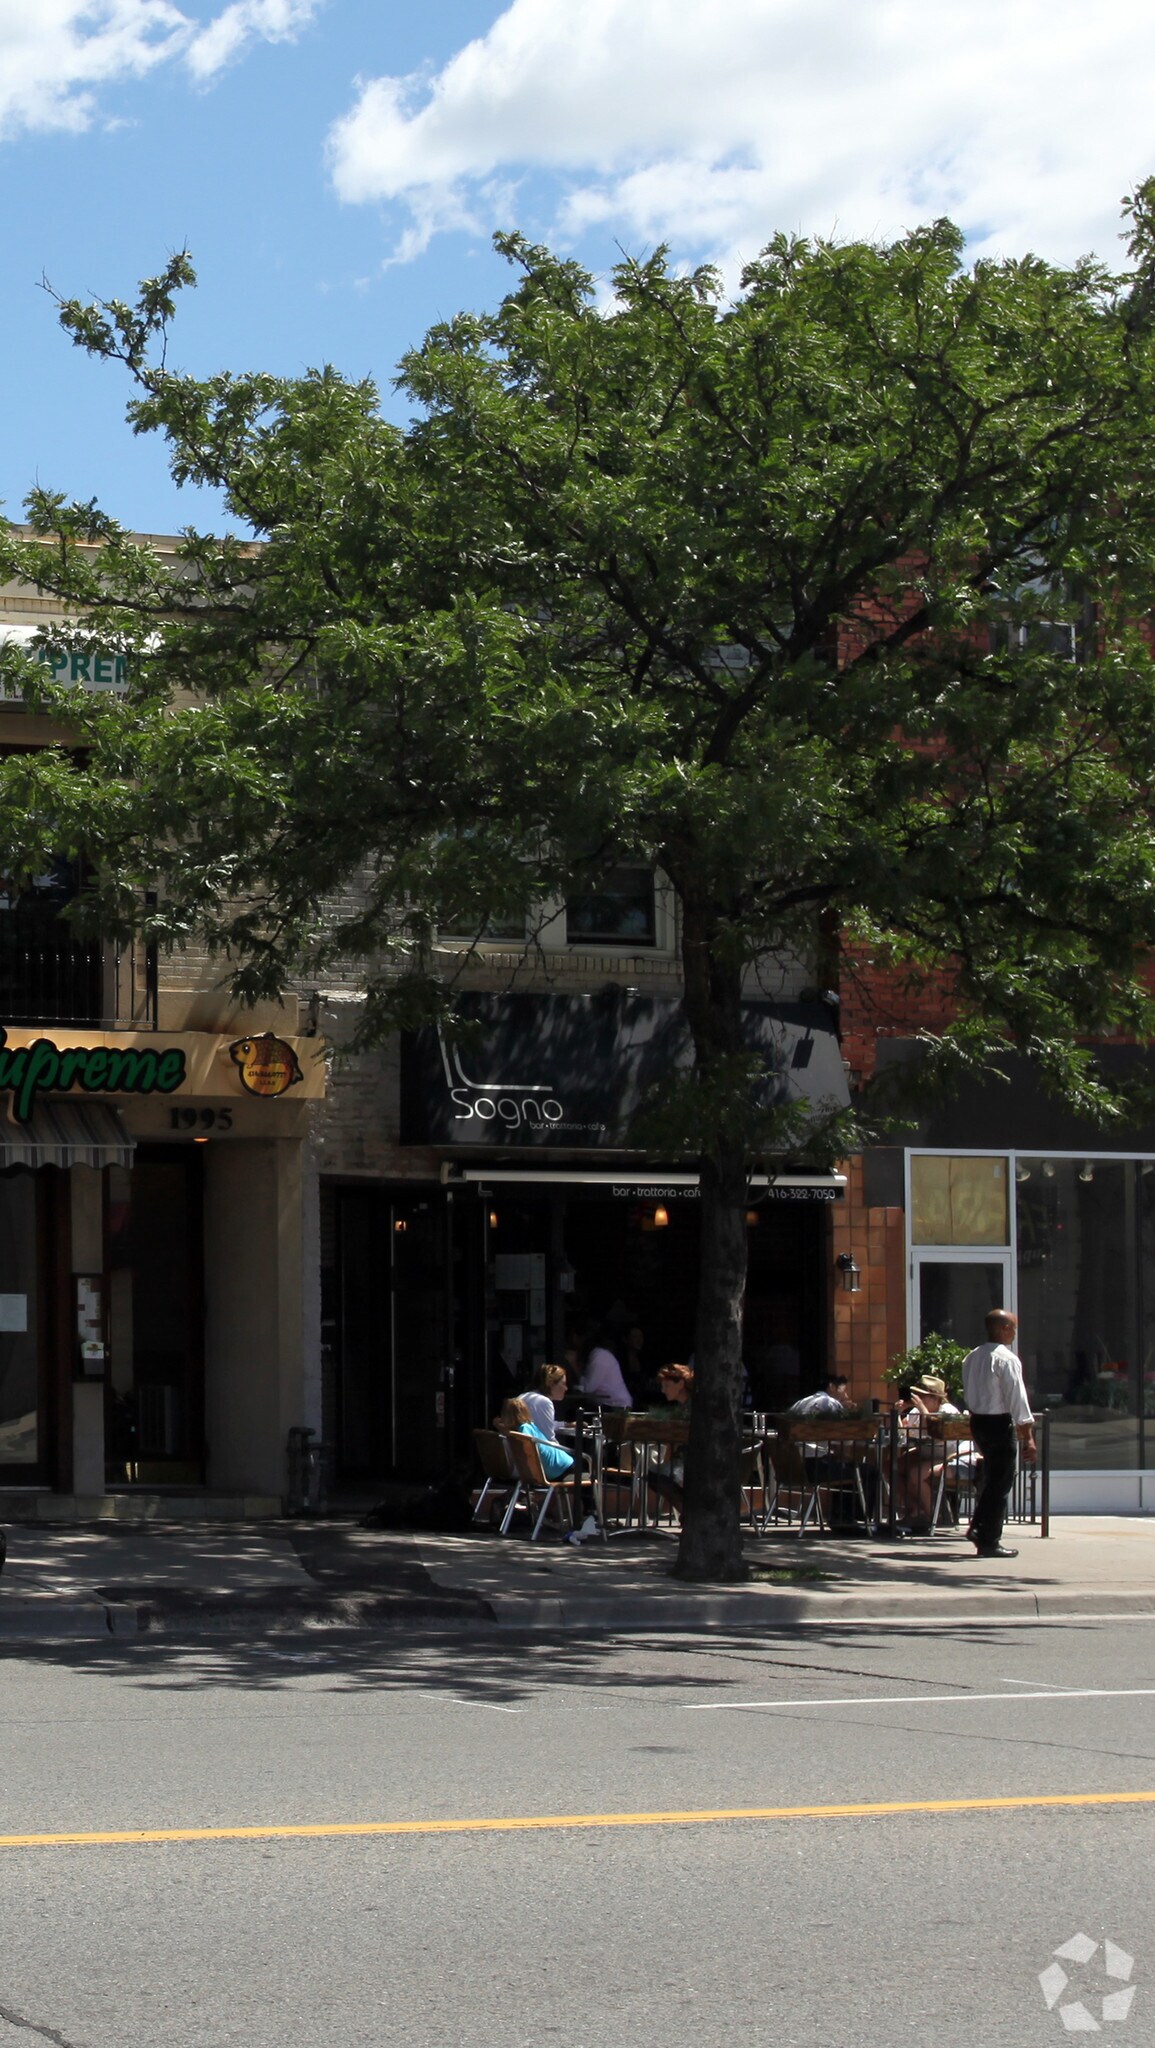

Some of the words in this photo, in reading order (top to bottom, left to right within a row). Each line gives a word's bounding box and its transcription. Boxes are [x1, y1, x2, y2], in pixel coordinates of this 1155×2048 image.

[0, 1027, 185, 1121] upreme
[171, 1107, 233, 1130] 1995
[450, 1088, 564, 1129] Sogno
[612, 1185, 631, 1197] bar
[637, 1186, 677, 1198] trattoria
[768, 1188, 836, 1200] 416-322-7050
